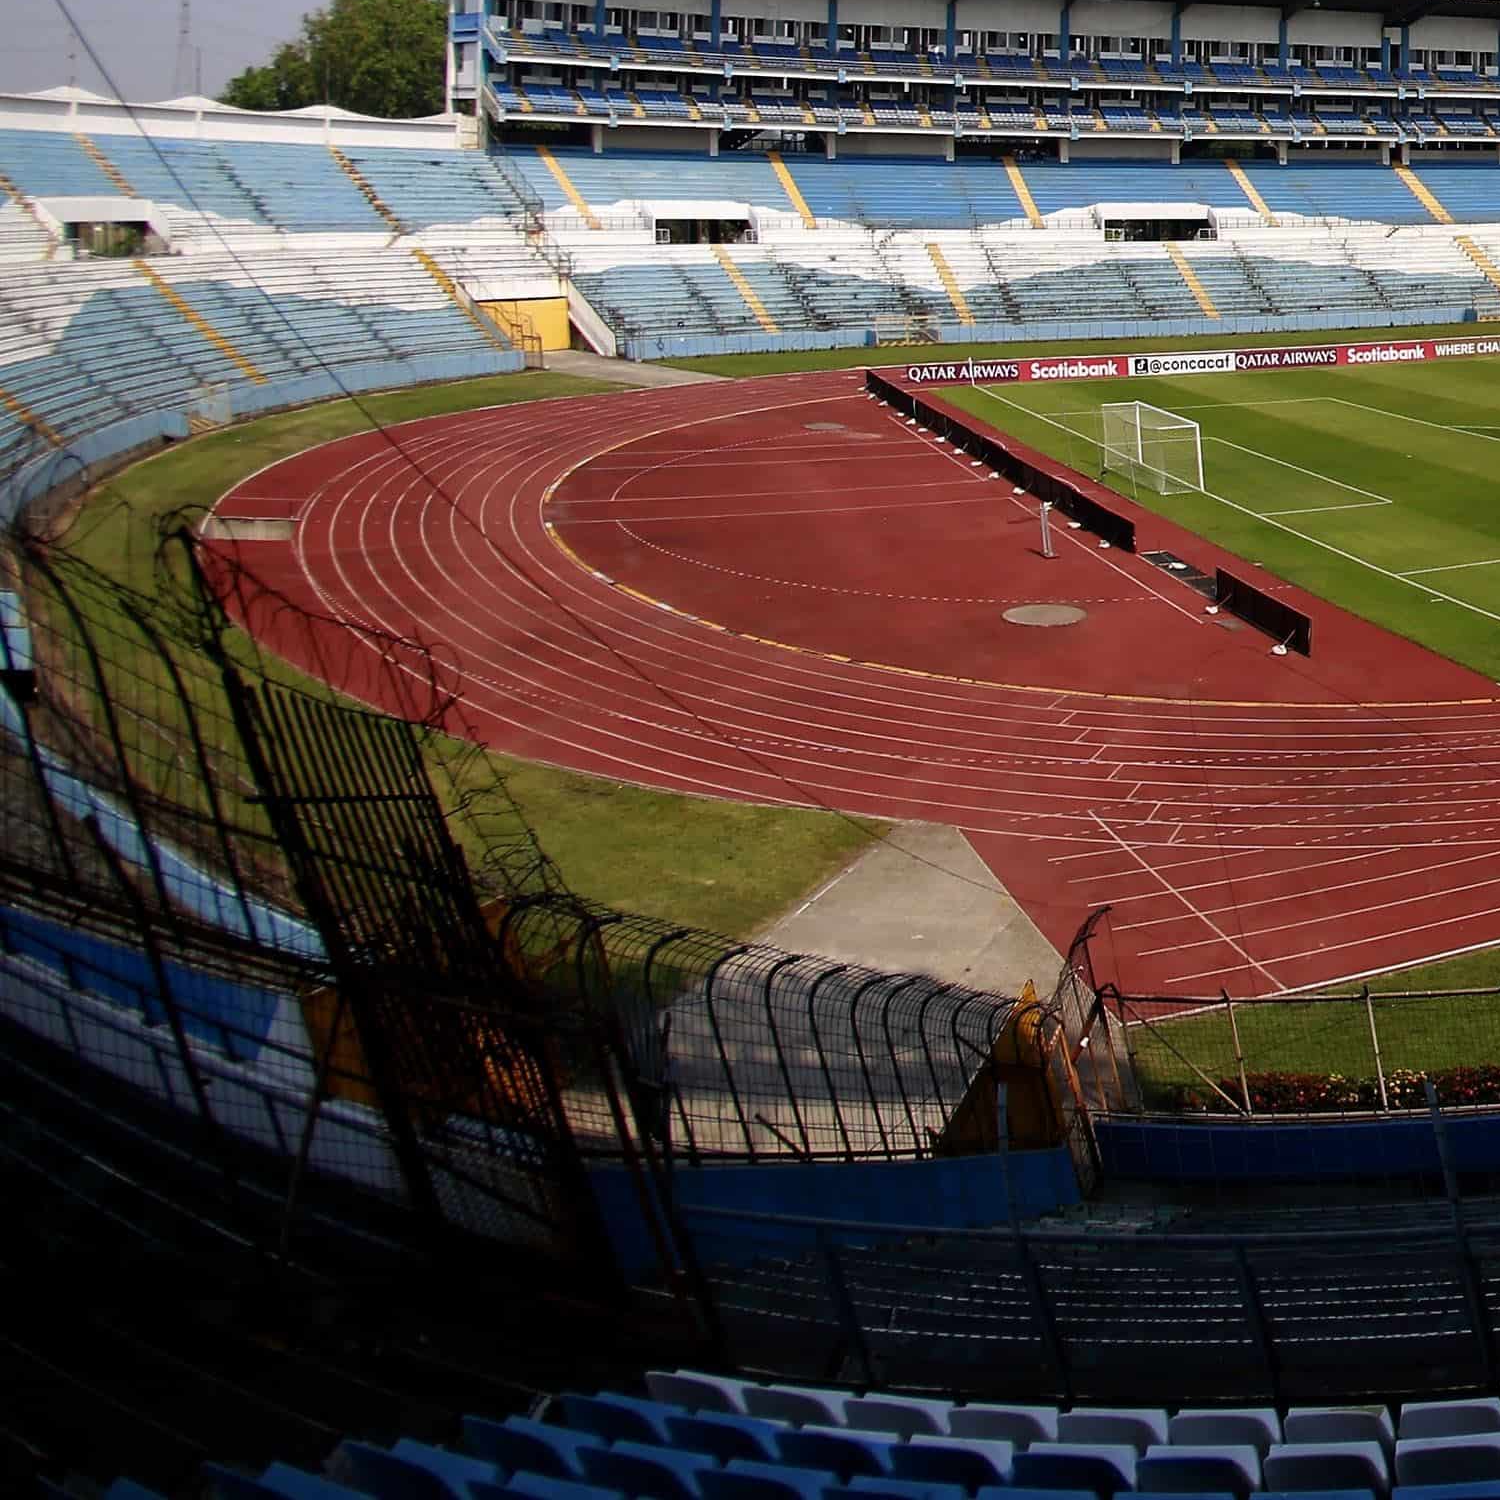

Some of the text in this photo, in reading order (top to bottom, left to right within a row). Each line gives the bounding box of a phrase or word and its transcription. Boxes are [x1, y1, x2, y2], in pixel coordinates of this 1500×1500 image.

[1347, 344, 1425, 364] Scotiabank
[1435, 342, 1475, 357] WHERE
[1149, 357, 1230, 374] @concacaf
[1236, 349, 1337, 370] QATAR AIRWAYS
[908, 364, 956, 383] QATAR
[1030, 360, 1118, 380] Scotiabank
